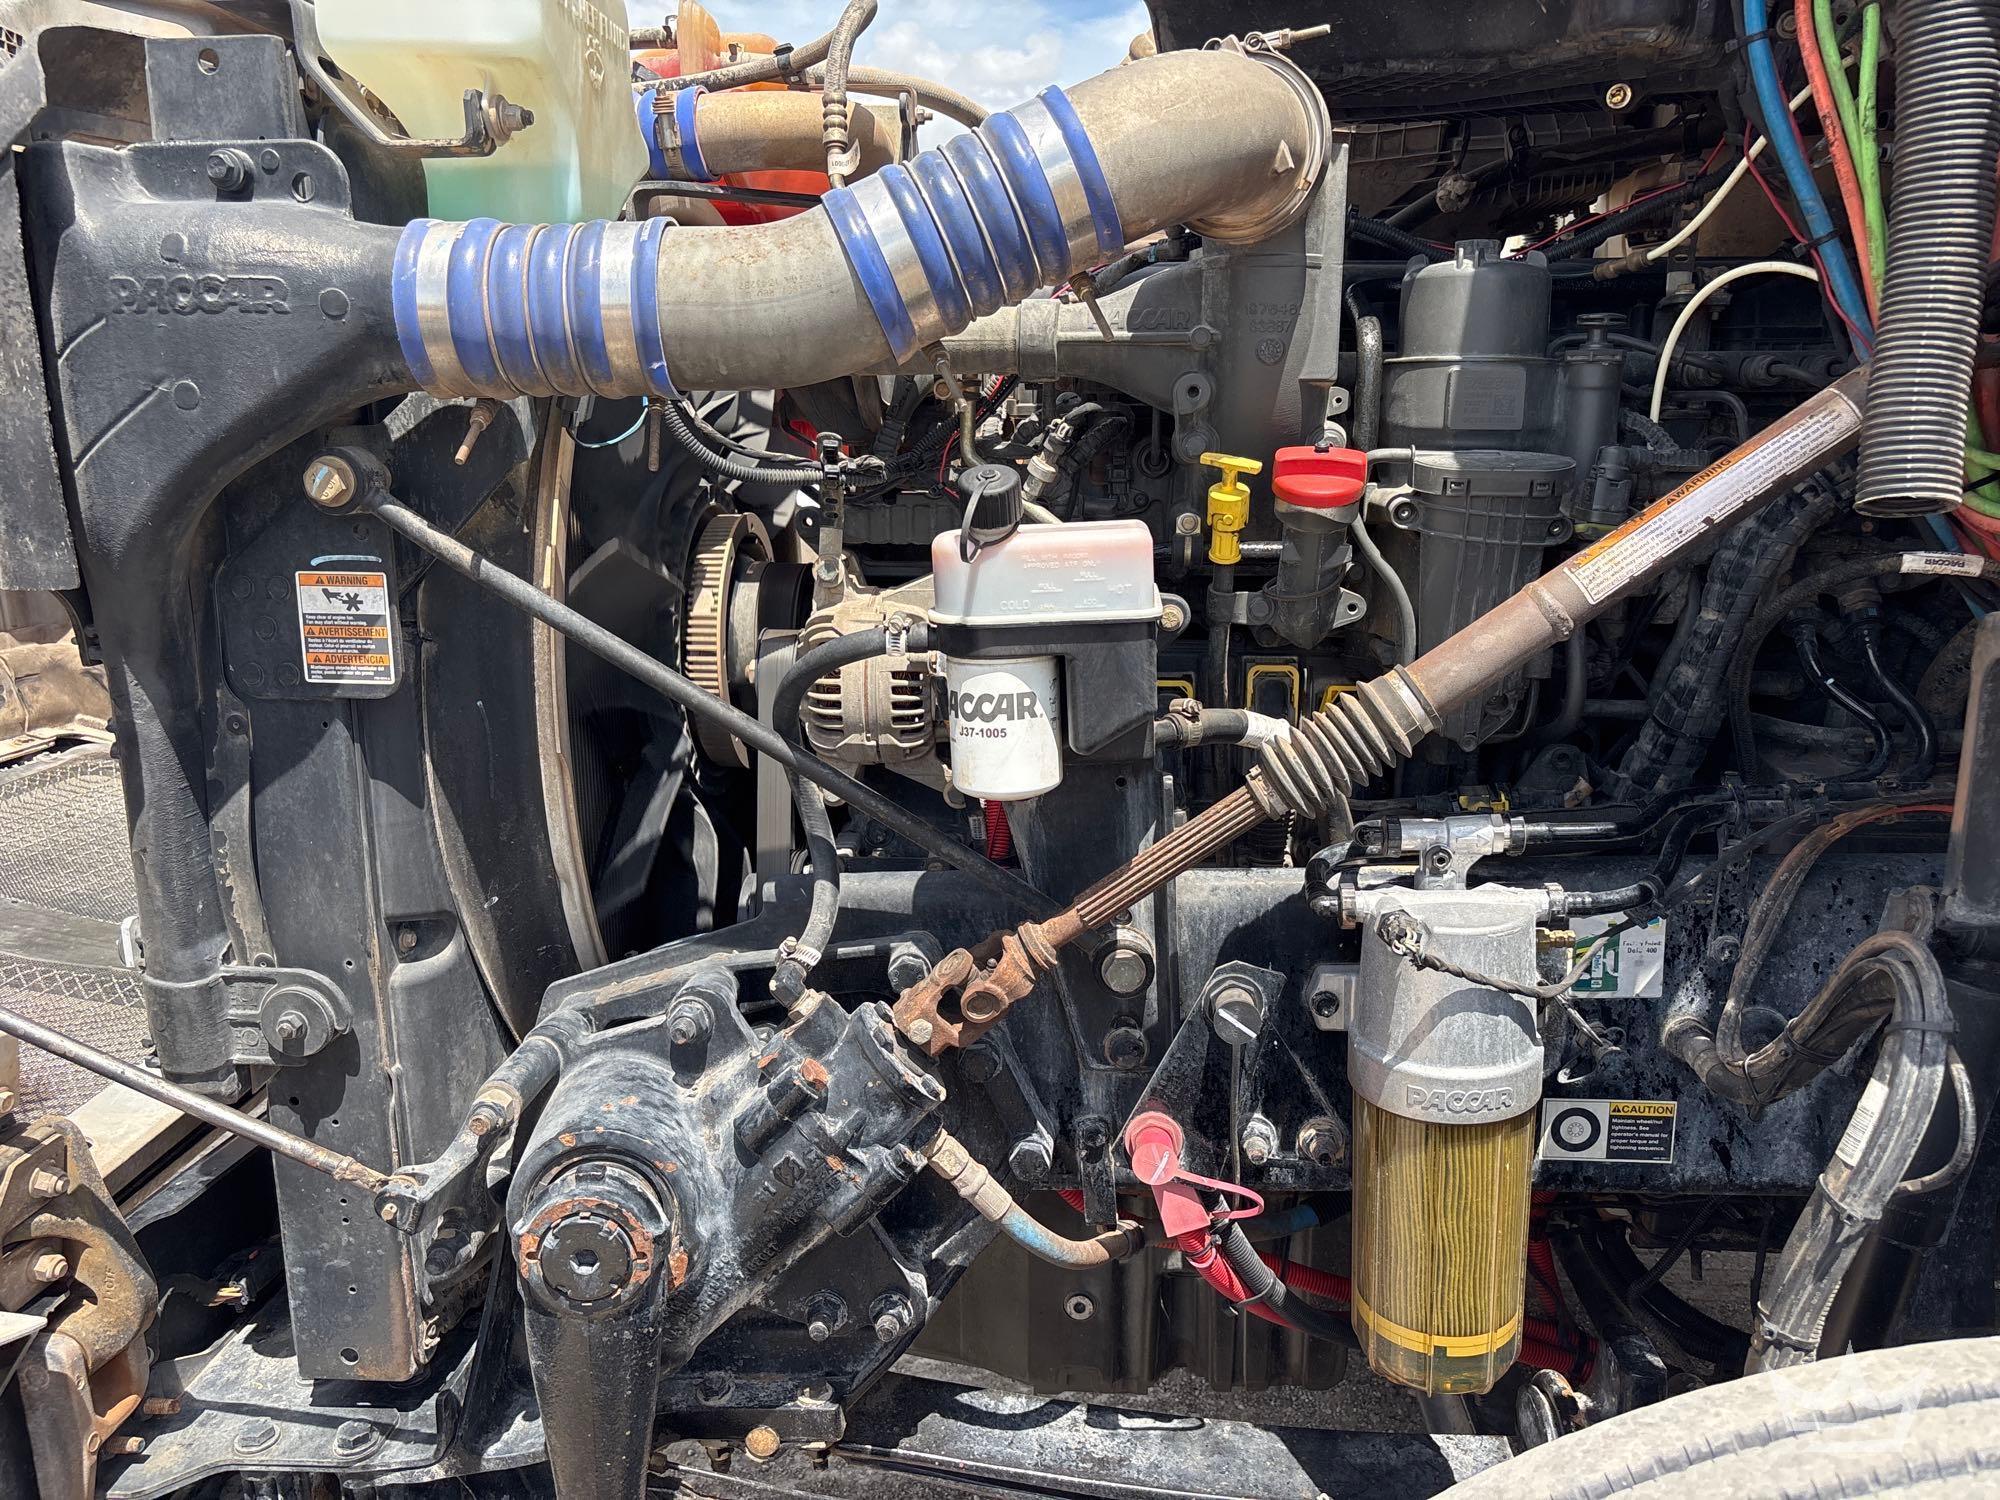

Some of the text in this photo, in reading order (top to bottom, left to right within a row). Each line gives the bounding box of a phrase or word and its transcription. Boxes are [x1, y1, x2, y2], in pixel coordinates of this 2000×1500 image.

[109, 273, 291, 314] PACCAR
[1671, 456, 1731, 500] WARNING
[1925, 558, 1965, 568] PACCAR
[326, 576, 368, 585] WARNING
[1000, 600, 1030, 610] COLD
[318, 627, 385, 637] AVERTISSEMENT
[325, 654, 384, 664] ADVERTENCIA
[949, 690, 1037, 723] ACCAR
[960, 726, 1007, 738] J37-1005
[1406, 1084, 1514, 1113] PACCAR
[1621, 1105, 1673, 1115] CAUTION
